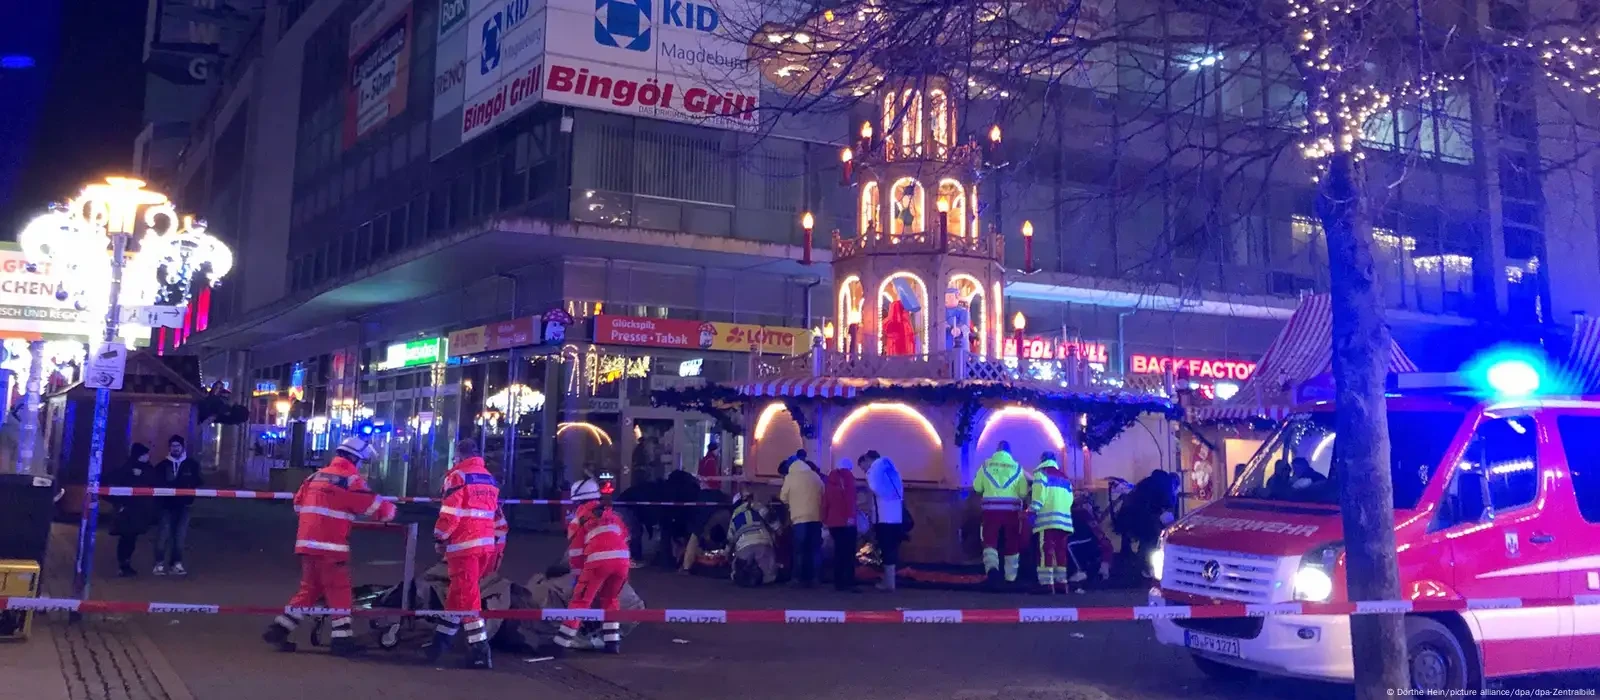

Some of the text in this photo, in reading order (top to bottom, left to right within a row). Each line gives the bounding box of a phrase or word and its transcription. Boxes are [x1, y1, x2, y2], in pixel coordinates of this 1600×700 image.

[442, 0, 465, 26] Bank
[507, 0, 529, 30] KID
[663, 0, 719, 33] KID
[661, 42, 749, 73] Magdeburg
[463, 85, 507, 133] Bingöl
[510, 63, 541, 106] Grill
[546, 64, 757, 120] Bingöl Grill
[0, 307, 21, 317] SCH
[612, 319, 656, 331] Glückspilz
[611, 330, 647, 342] Presse
[656, 334, 688, 345] Tabak
[747, 329, 793, 347] LOTTO
[1190, 515, 1320, 537] FEUERWEHR
